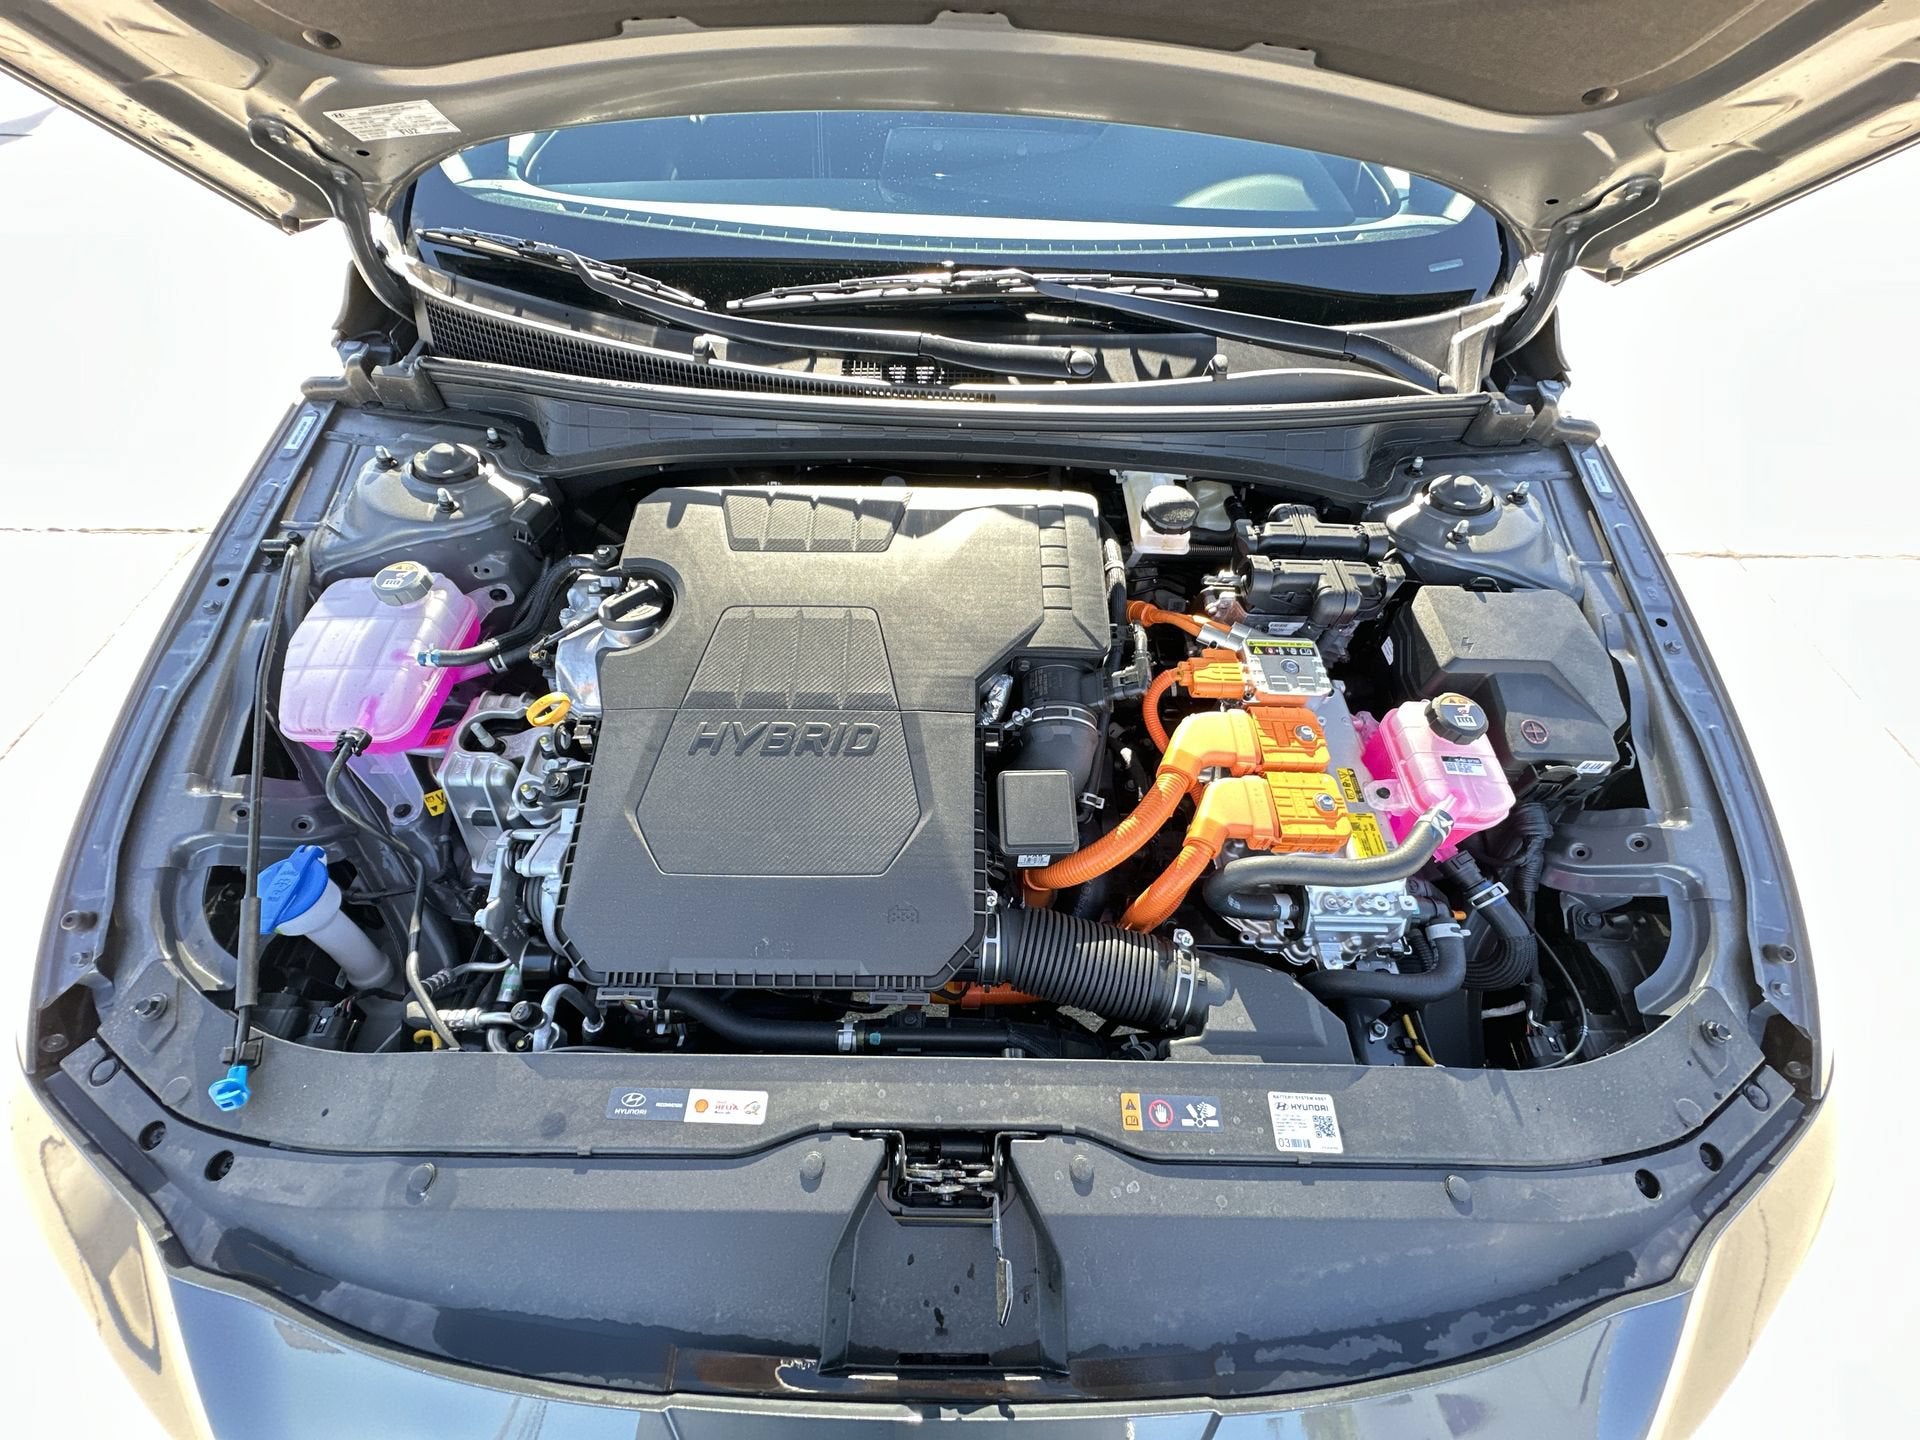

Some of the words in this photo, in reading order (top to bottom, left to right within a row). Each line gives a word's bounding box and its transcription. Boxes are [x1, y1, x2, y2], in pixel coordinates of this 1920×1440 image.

[688, 721, 881, 757] HYBRID
[1290, 1103, 1329, 1111] HYUNDAI
[614, 1108, 648, 1116] HYUNDAI
